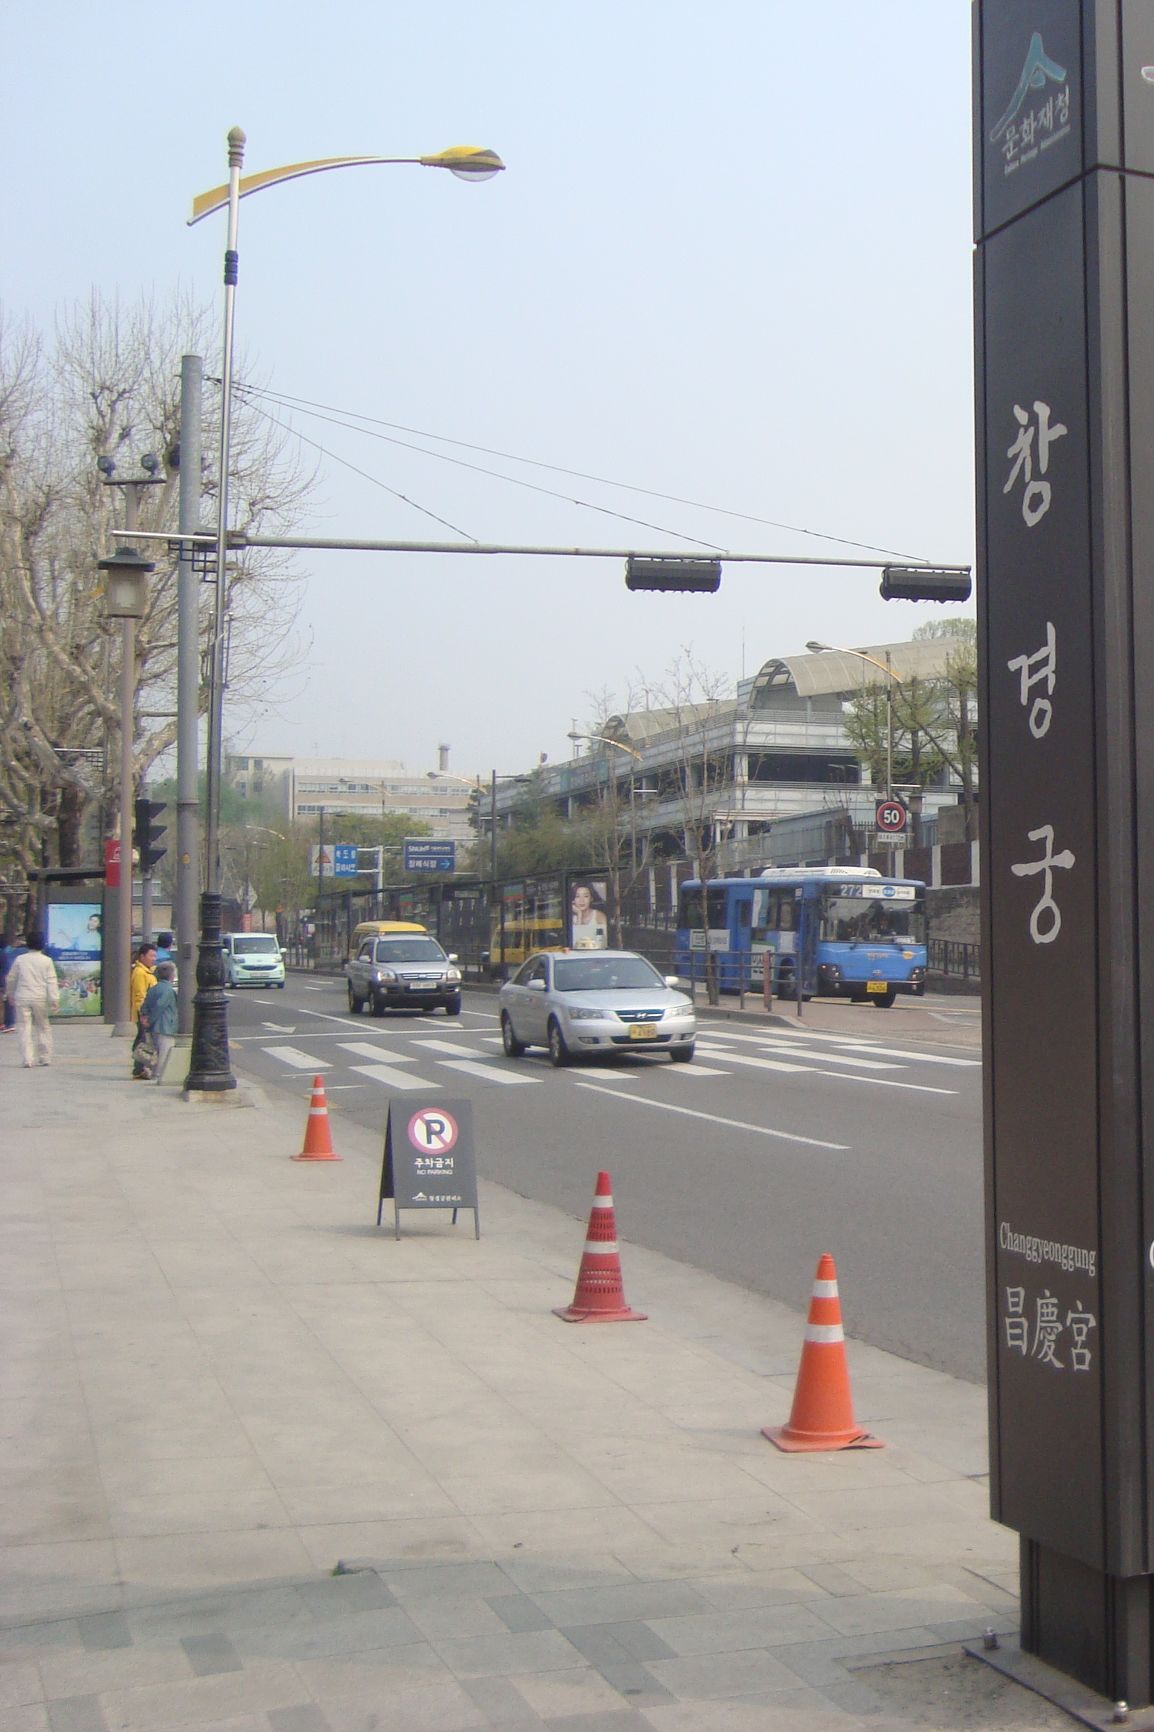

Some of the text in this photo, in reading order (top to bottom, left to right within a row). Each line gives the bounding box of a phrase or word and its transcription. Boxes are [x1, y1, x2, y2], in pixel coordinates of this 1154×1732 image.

[1002, 85, 1070, 159] 문화재청
[1003, 400, 1076, 944] 창경궁
[883, 810, 900, 823] 50
[841, 884, 862, 897] 272
[425, 1119, 446, 1145] P
[414, 1157, 454, 1169] 주차금지
[999, 1221, 1096, 1277] Changgyeonggung
[1004, 1286, 1097, 1371] 昌慶宮
